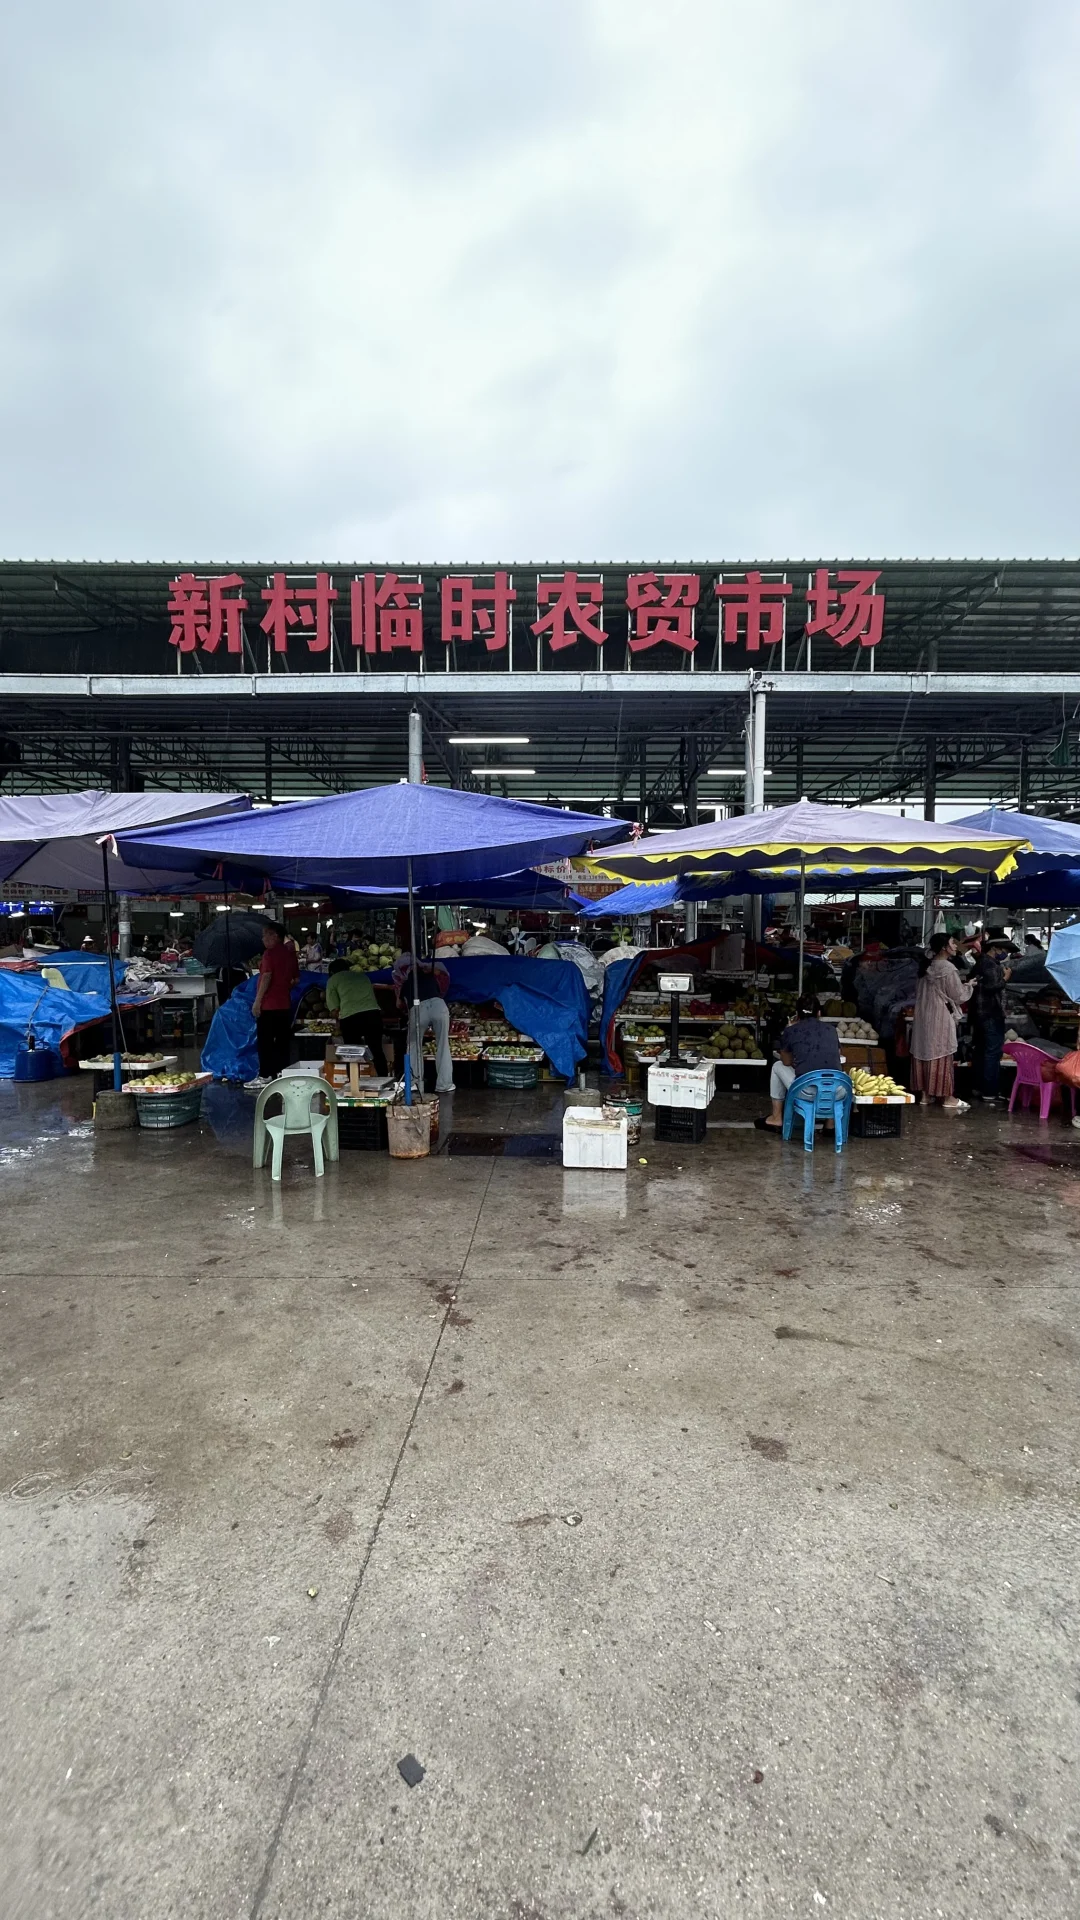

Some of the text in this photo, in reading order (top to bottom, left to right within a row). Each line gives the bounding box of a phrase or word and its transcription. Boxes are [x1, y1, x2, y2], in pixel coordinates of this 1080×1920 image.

[168, 569, 884, 655] 新村临时农贸市场
